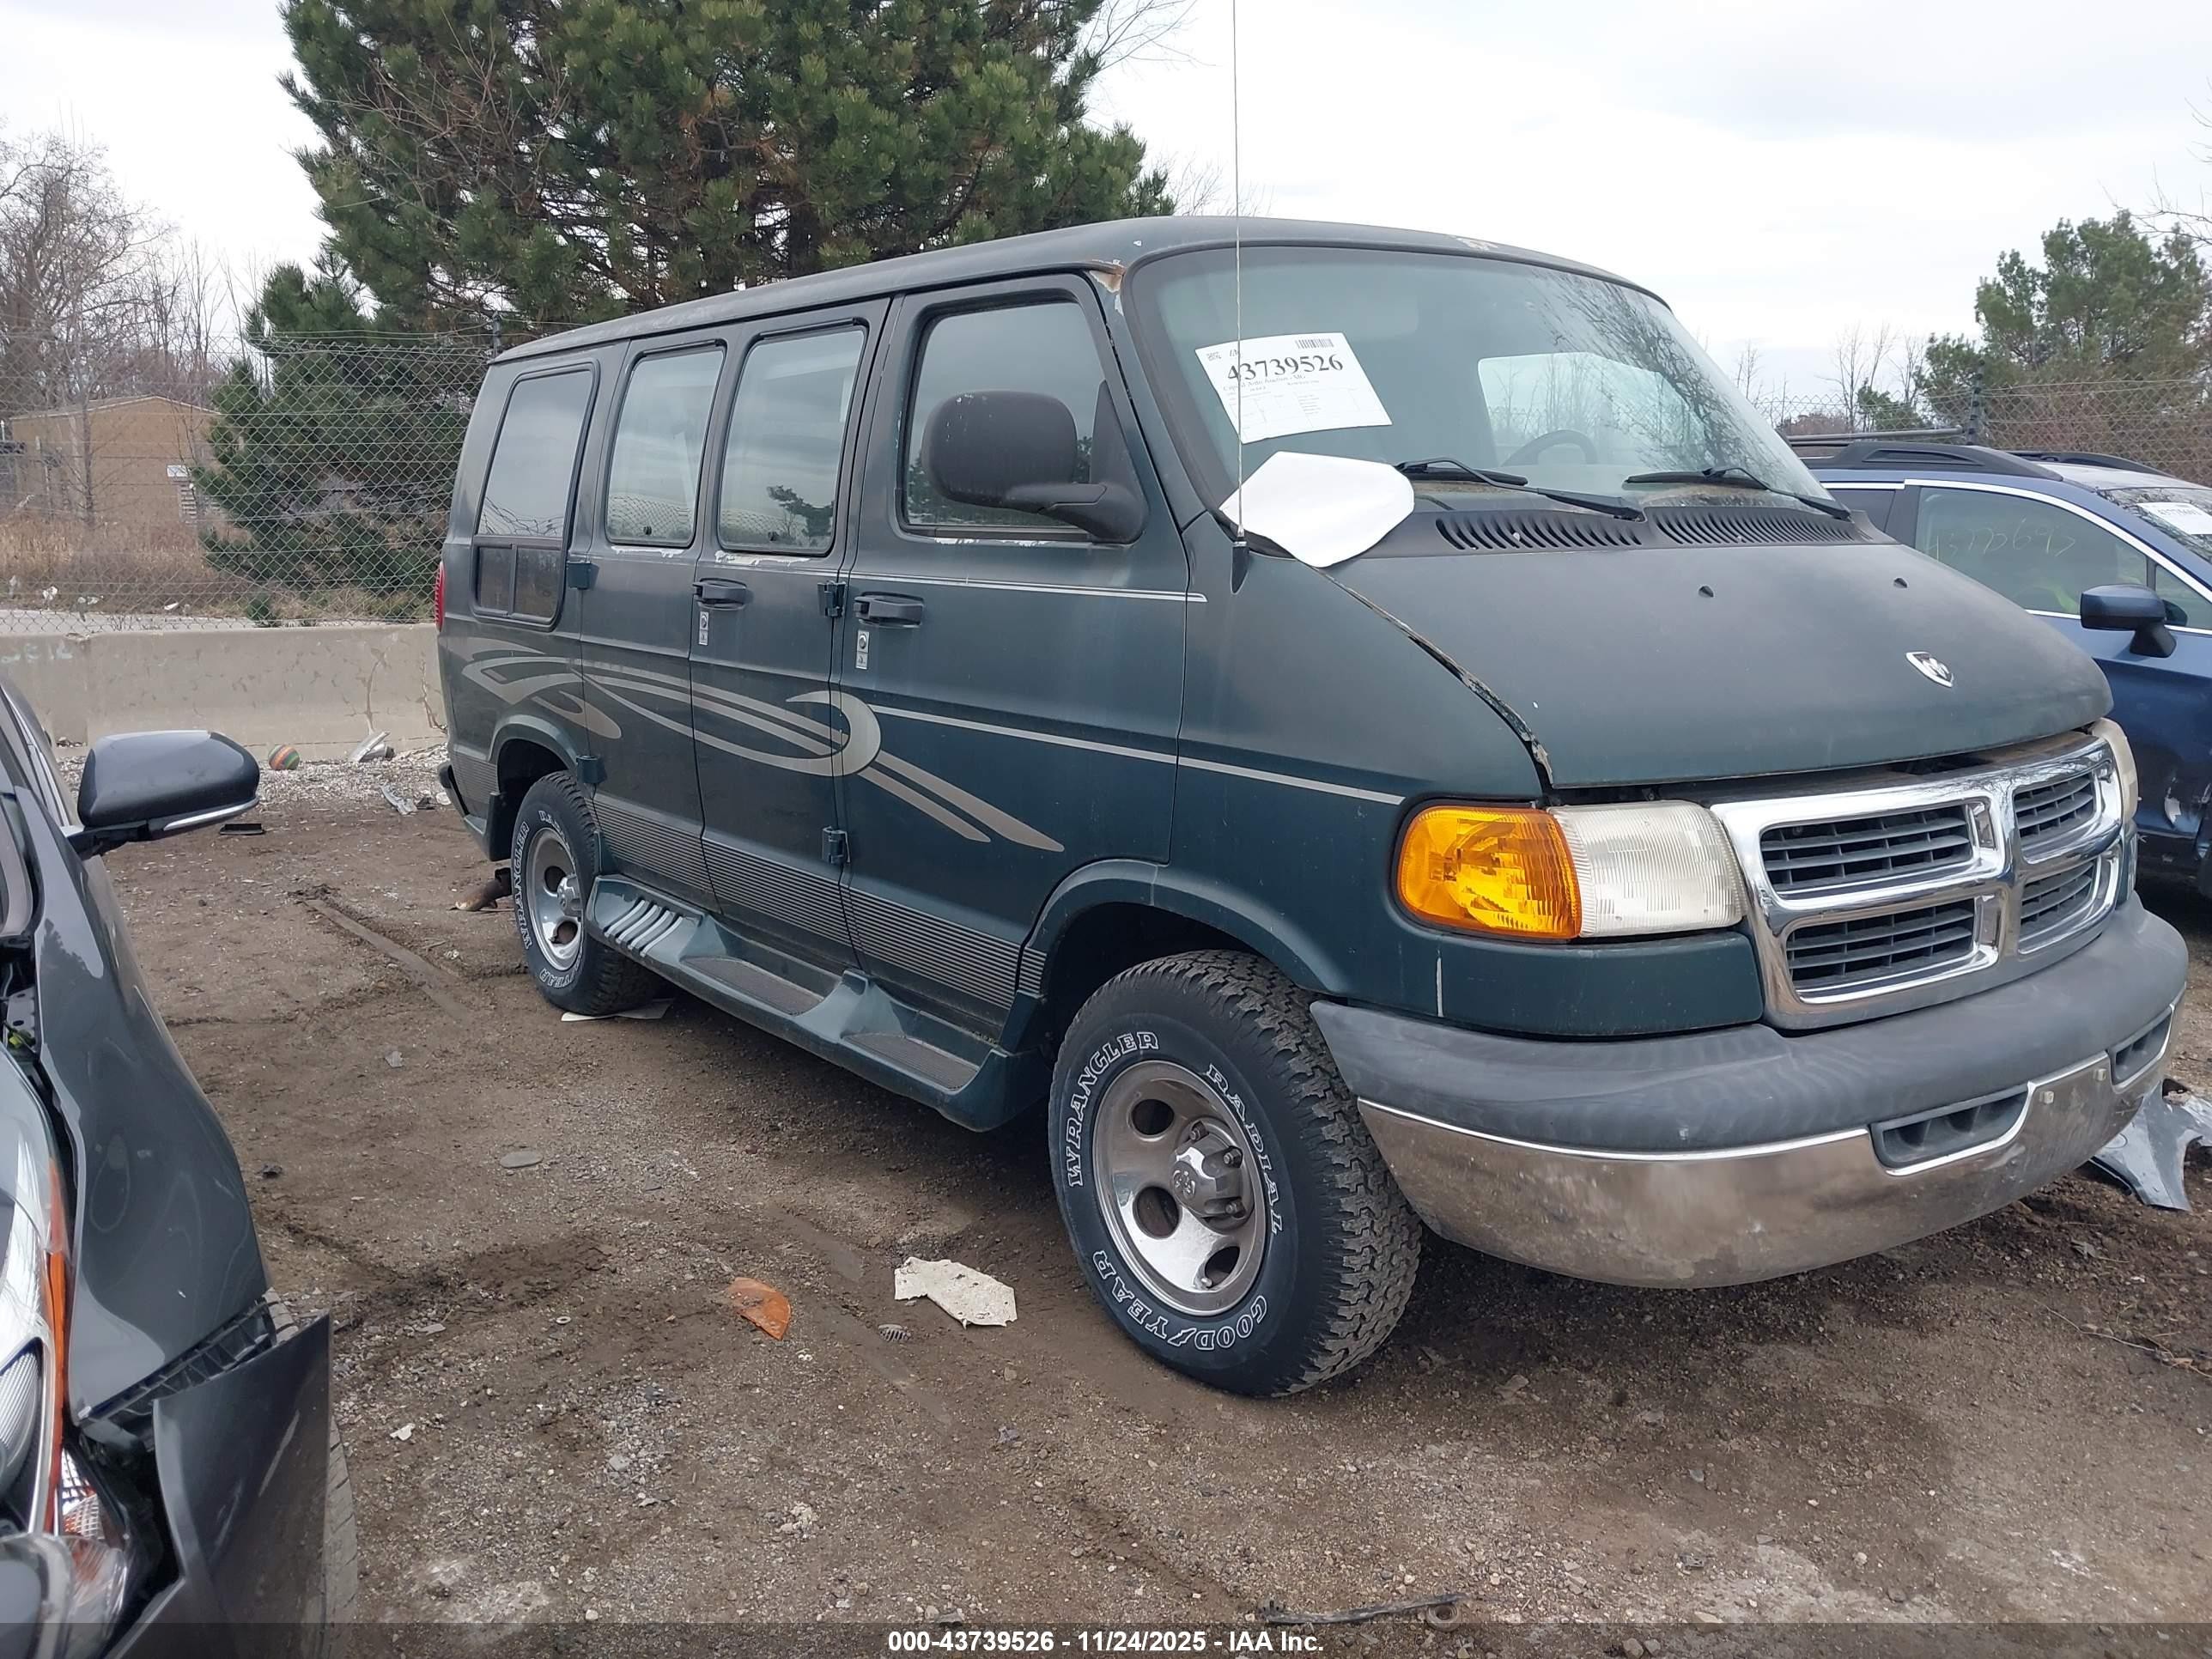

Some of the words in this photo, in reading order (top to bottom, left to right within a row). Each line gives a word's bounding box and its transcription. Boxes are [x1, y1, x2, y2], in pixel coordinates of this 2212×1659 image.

[1227, 354, 1344, 382] 43739526
[1066, 1031, 1159, 1187] WRANGLER
[1206, 1063, 1284, 1235] RADIAL
